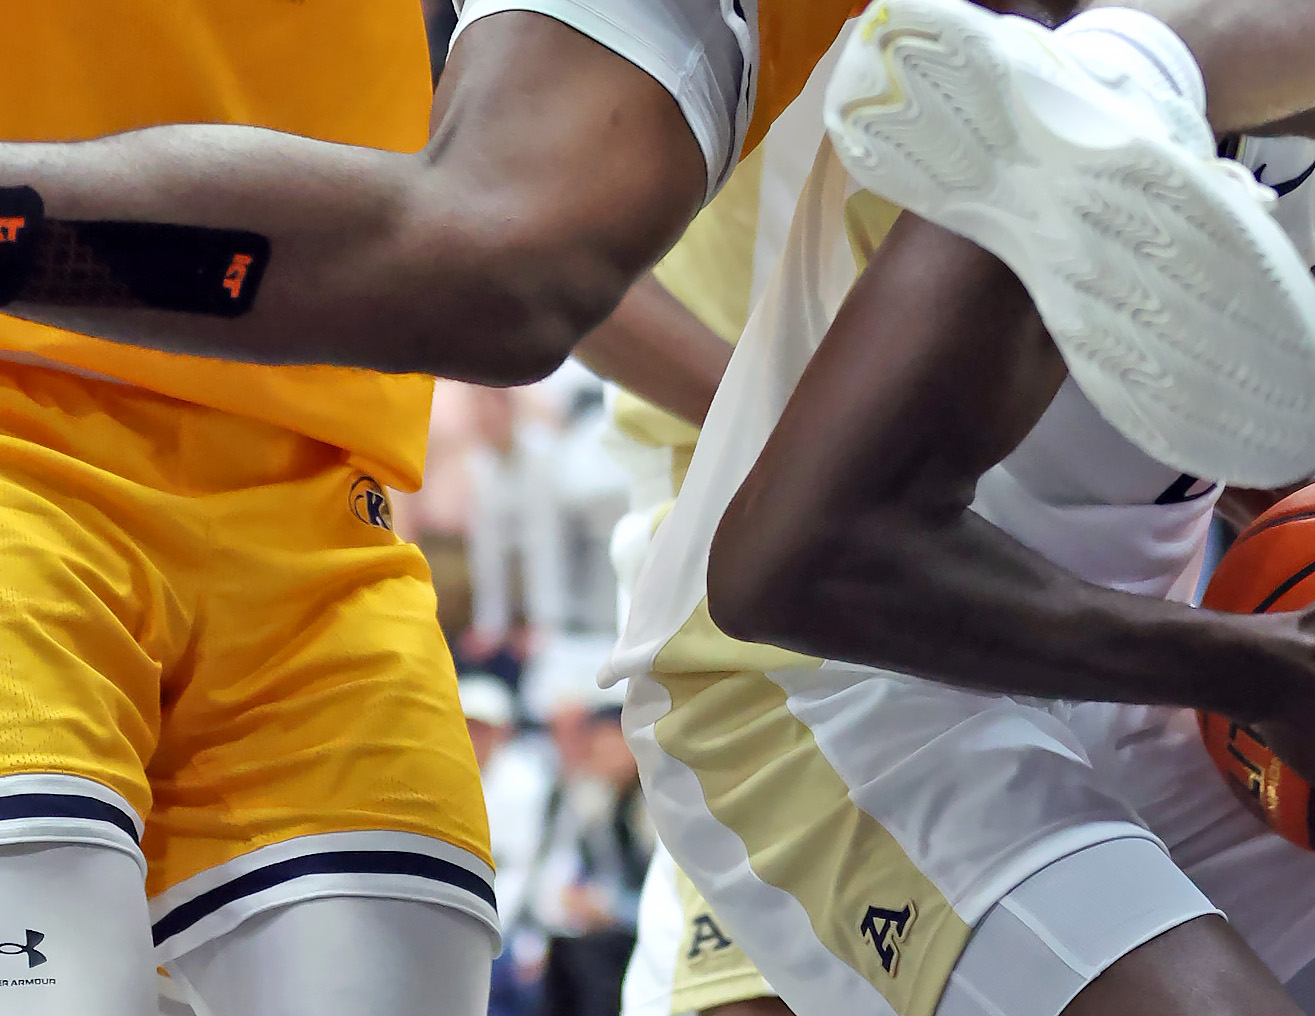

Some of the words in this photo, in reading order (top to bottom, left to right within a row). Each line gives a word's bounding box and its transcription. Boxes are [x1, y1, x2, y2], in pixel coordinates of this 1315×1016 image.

[687, 914, 733, 959] A
[860, 898, 919, 979] A
[11, 978, 56, 986] ARMOUR
